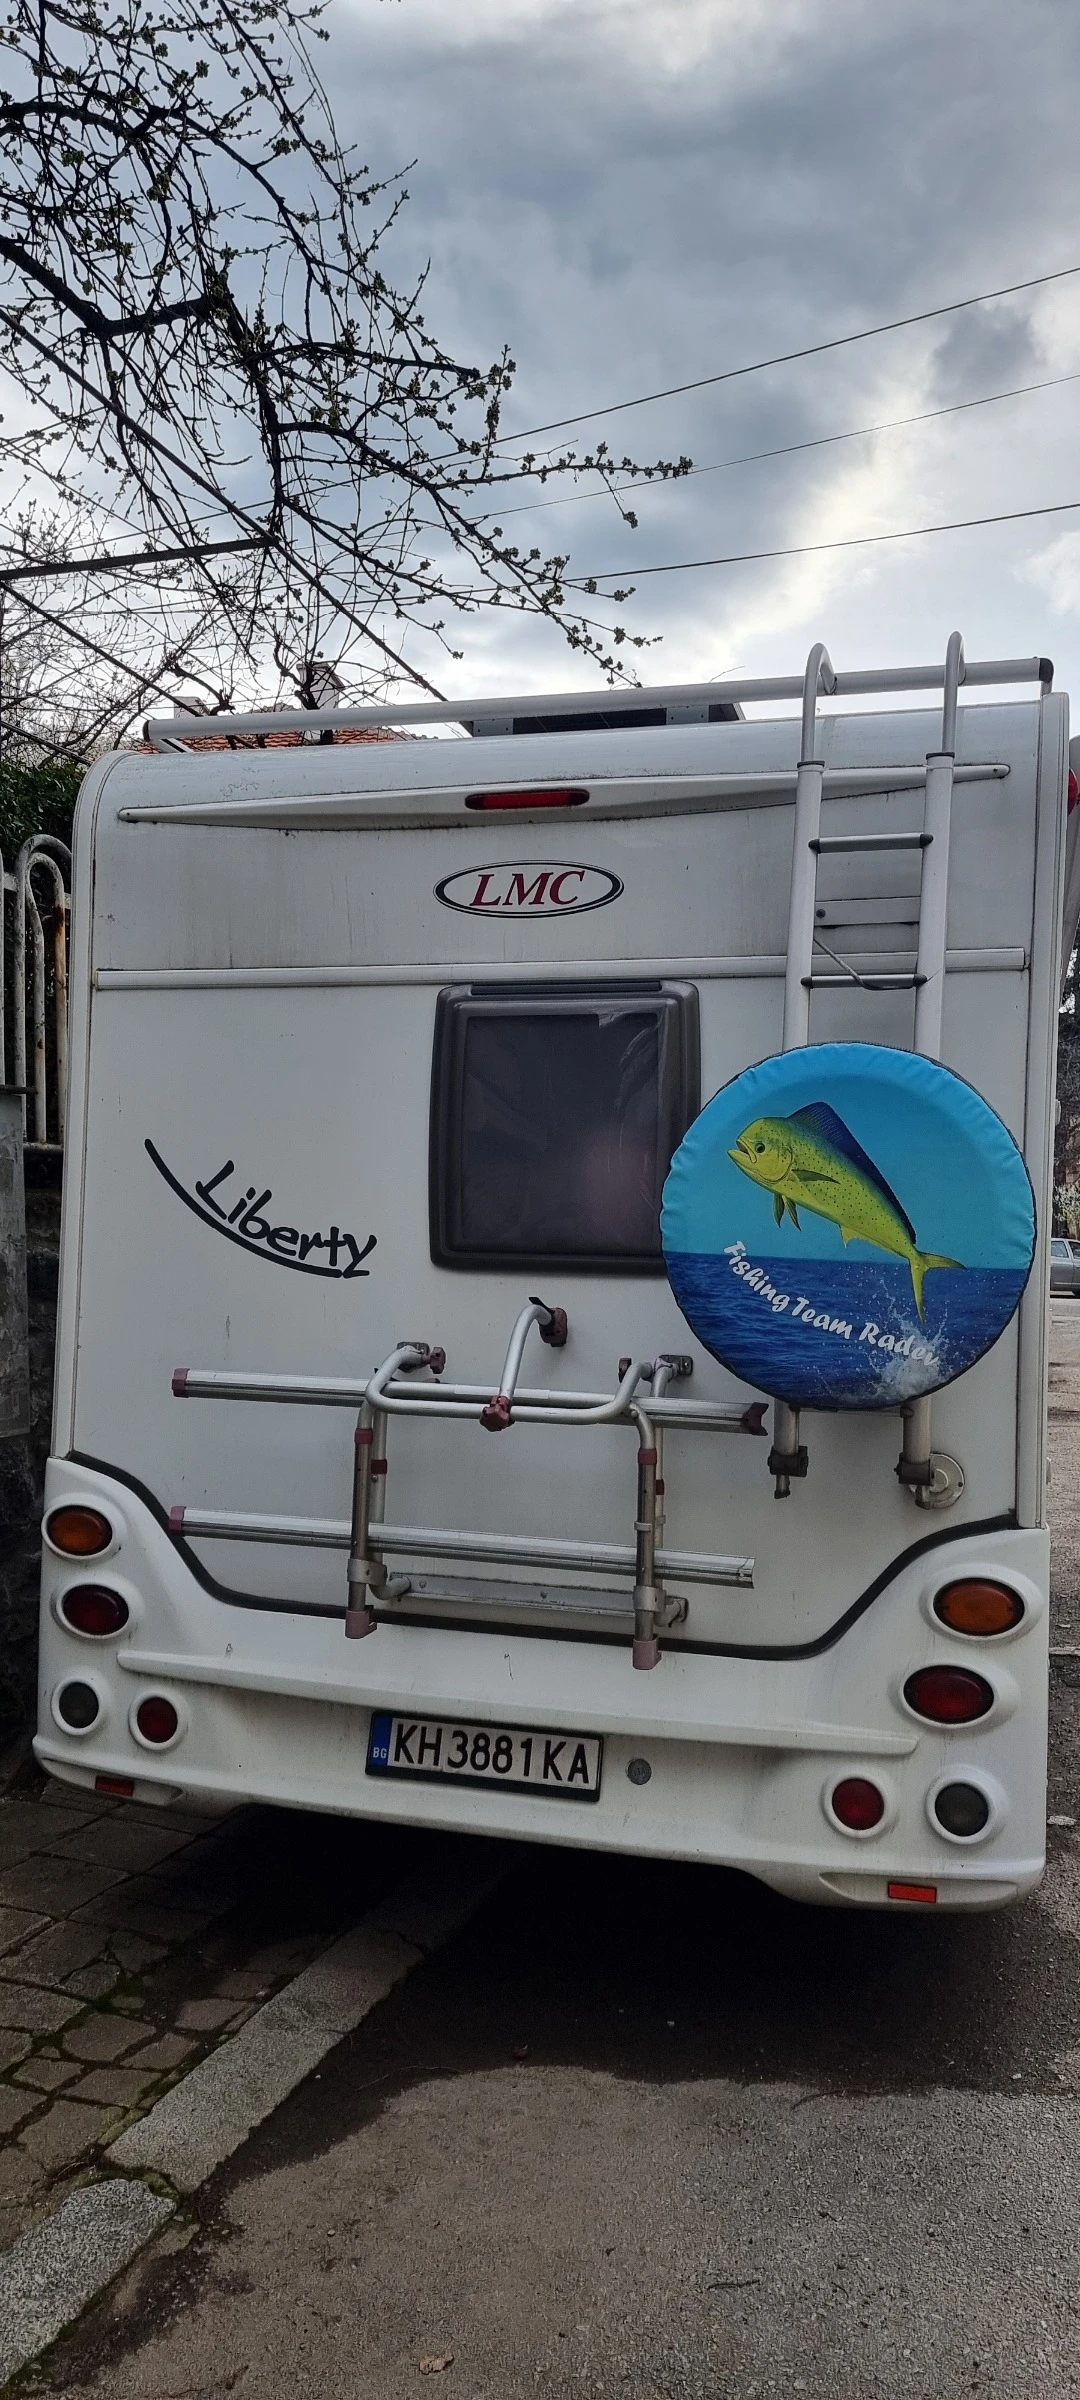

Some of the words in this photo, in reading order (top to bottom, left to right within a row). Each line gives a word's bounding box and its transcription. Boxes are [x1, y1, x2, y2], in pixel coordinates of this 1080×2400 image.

[469, 870, 585, 906] LMC
[195, 1160, 377, 1279] Liberty
[723, 1241, 790, 1312] Fishing
[791, 1296, 853, 1340] Team
[858, 1322, 940, 1366] Radev
[372, 1746, 388, 1759] BG
[394, 1723, 589, 1784] KH3881KA
